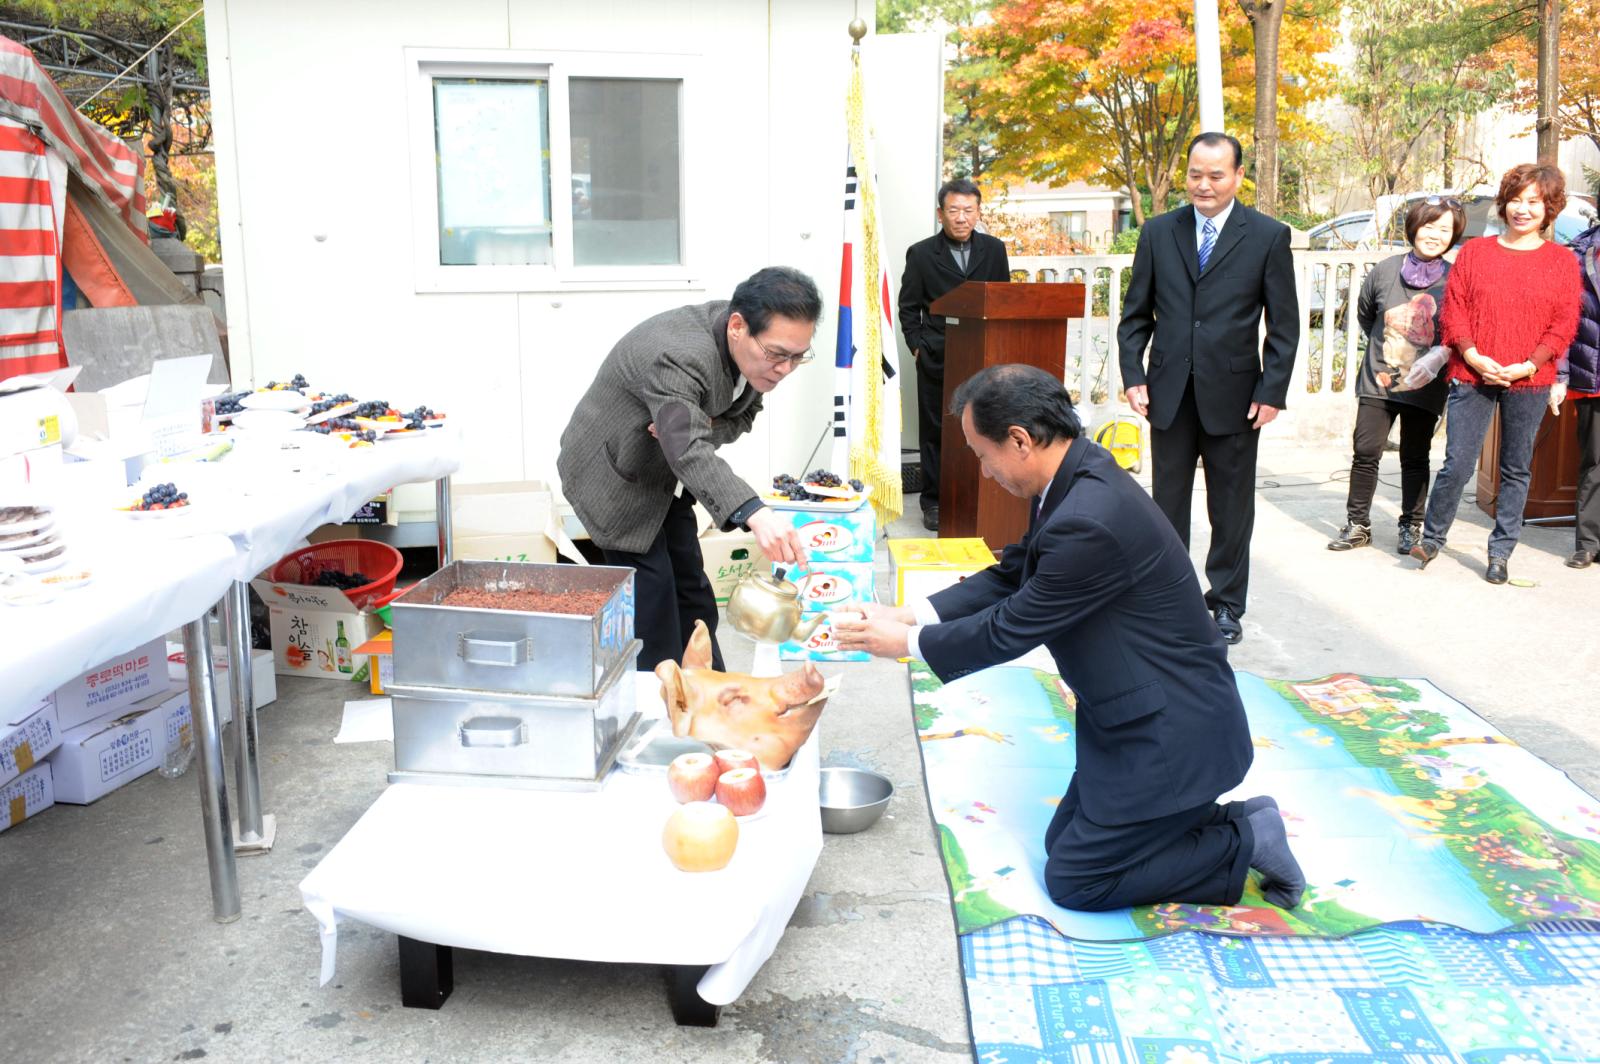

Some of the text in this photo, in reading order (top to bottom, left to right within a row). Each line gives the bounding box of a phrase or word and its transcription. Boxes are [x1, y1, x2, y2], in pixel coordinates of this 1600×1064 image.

[810, 534, 836, 547] Sun
[809, 585, 835, 598] Sun
[289, 615, 313, 661] 참이슬
[808, 634, 834, 648] Sun
[86, 656, 149, 688] 종로떡마트
[1048, 987, 1066, 1029] nature
[1358, 1000, 1390, 1041] nature
[1378, 996, 1401, 1026] Here
[1074, 1019, 1089, 1029] is
